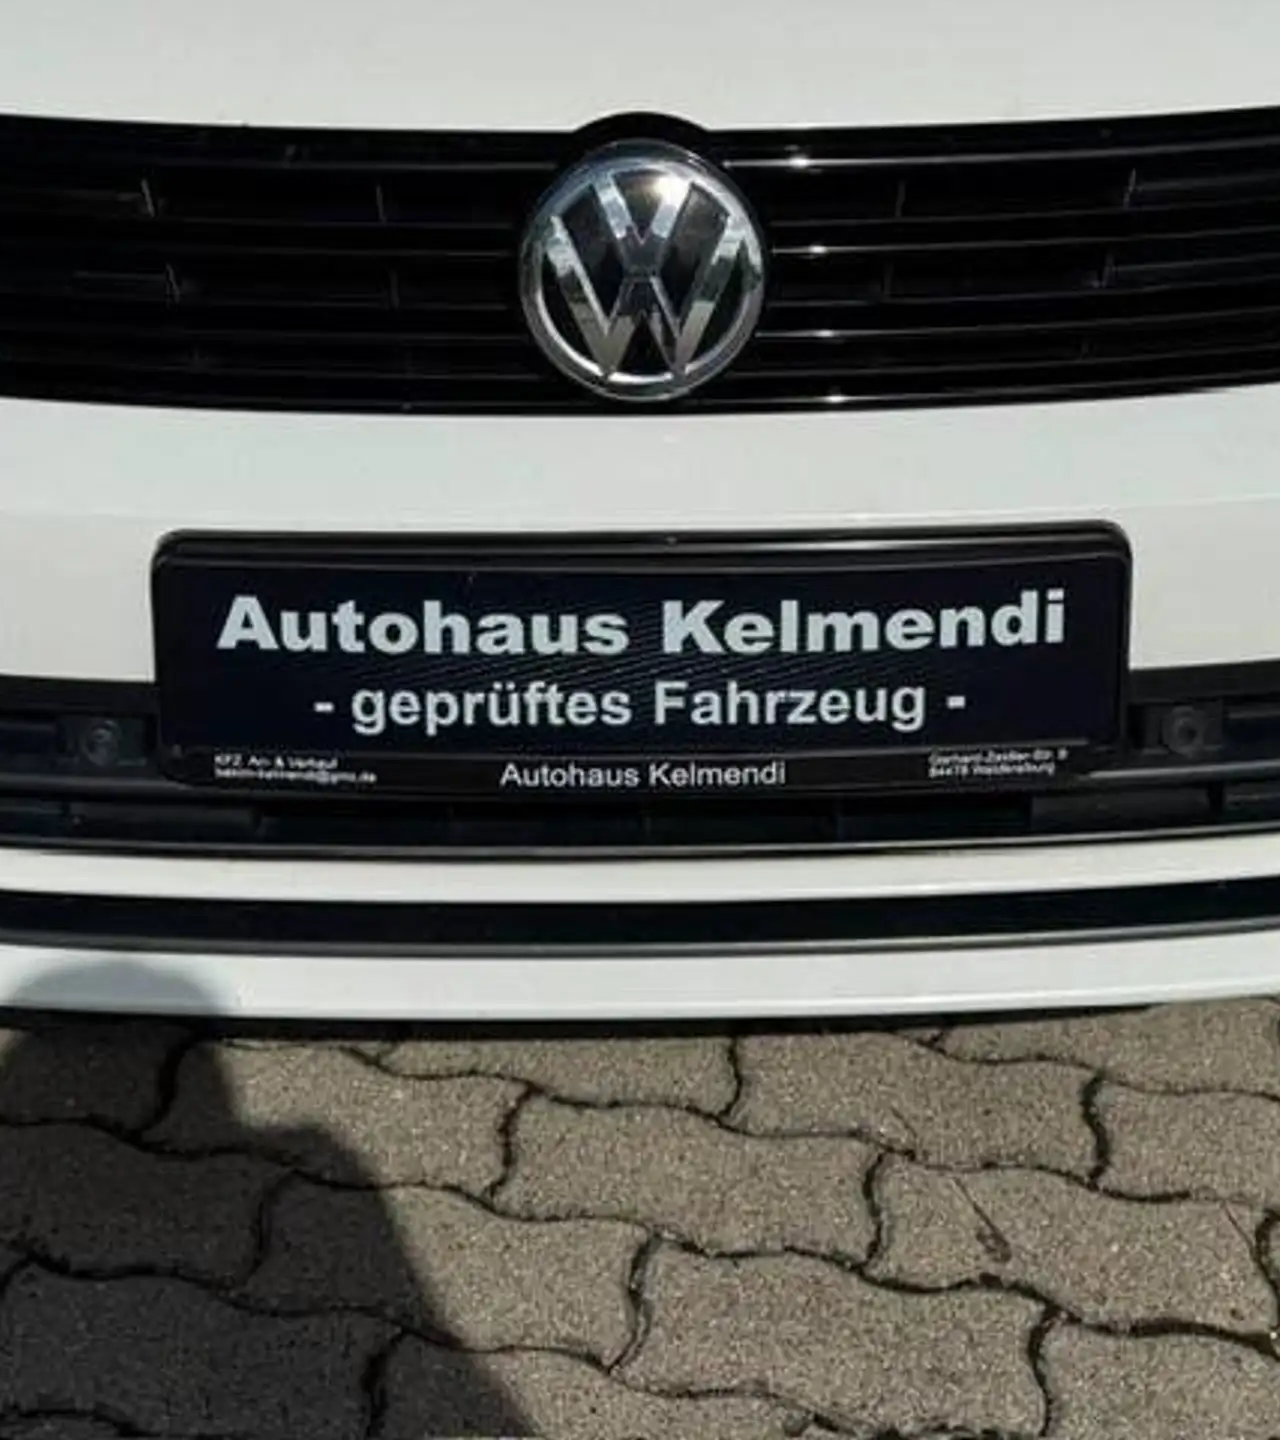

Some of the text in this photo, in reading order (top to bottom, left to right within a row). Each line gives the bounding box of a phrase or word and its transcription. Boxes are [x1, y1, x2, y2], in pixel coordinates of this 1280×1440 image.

[216, 587, 1066, 656] Autohaus Kelmendi
[350, 680, 633, 737] geprüftes
[653, 679, 926, 733] Fahrzeug
[499, 760, 787, 788] Autohaus Kelmendi
